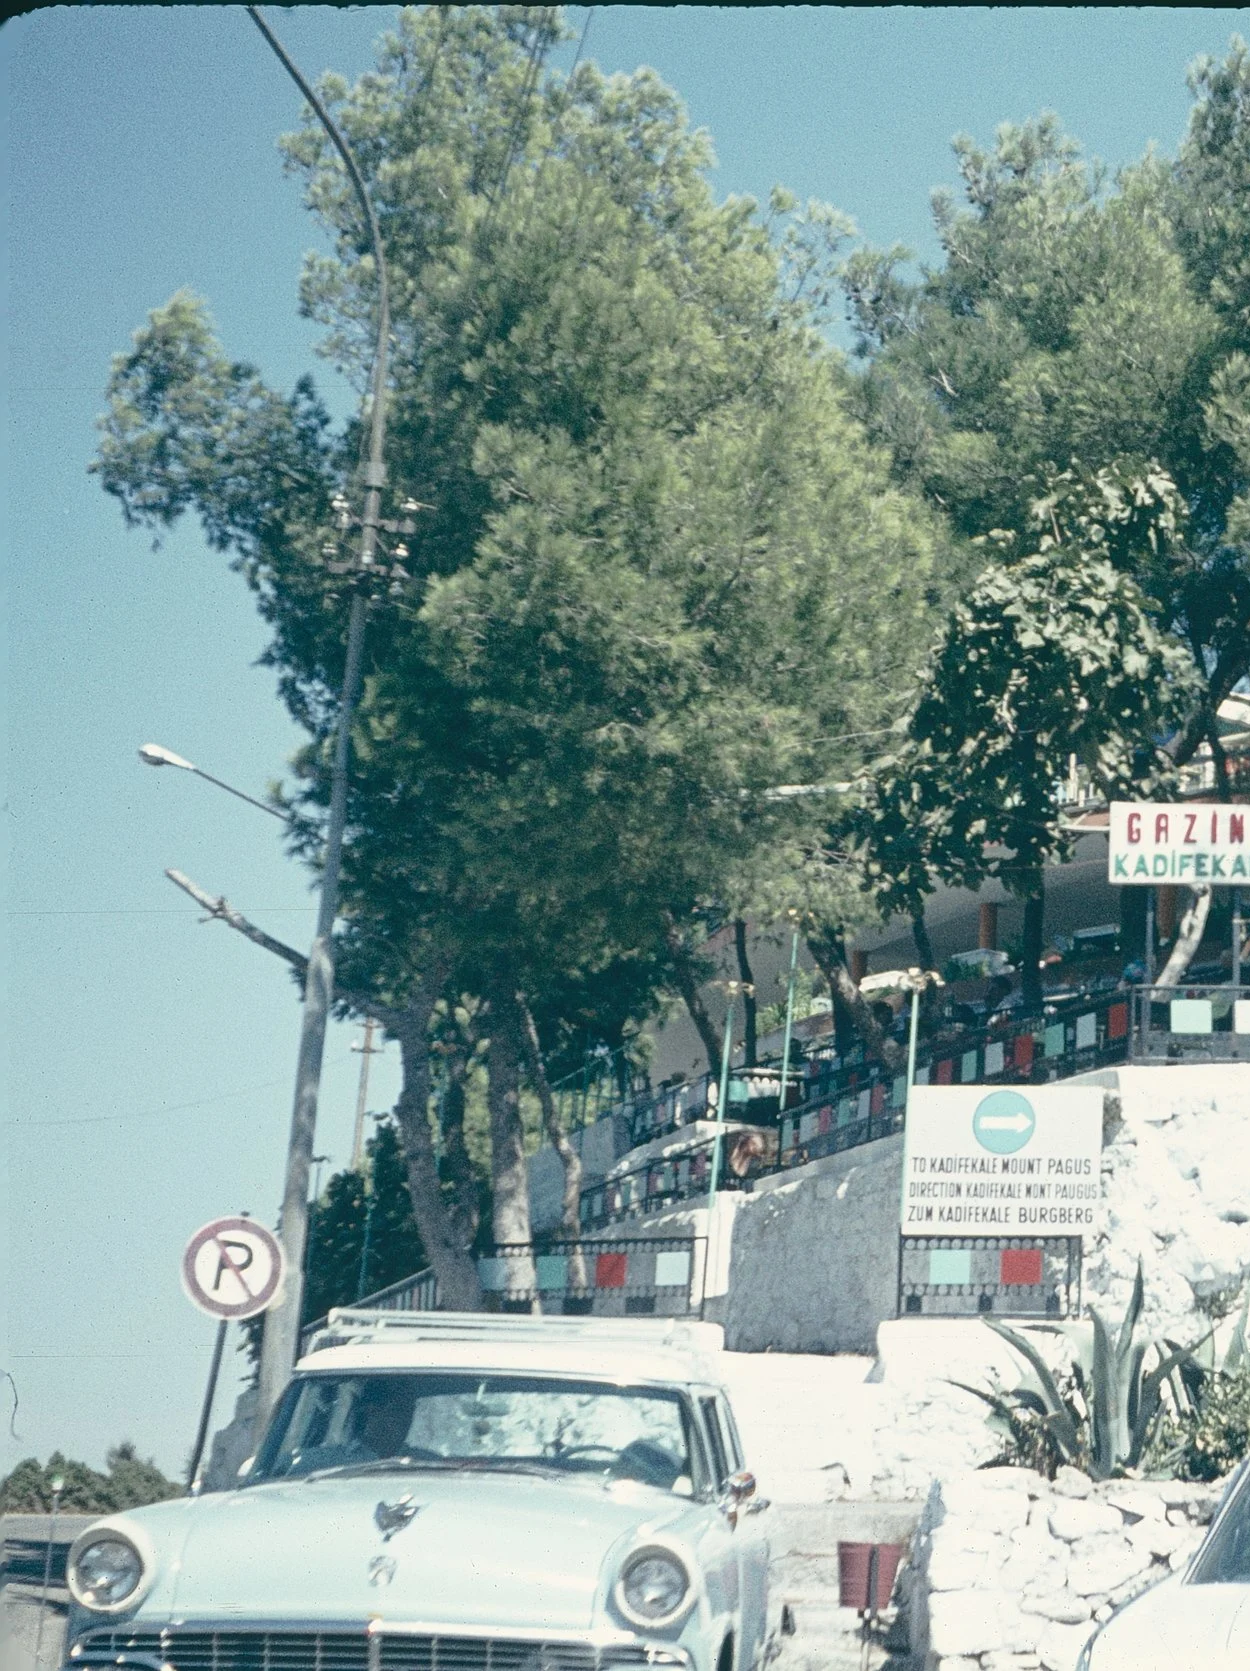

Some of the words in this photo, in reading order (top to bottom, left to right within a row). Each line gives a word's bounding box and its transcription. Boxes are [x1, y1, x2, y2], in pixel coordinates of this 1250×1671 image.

[912, 1157, 927, 1174] TO
[930, 1153, 998, 1174] KADİFEKALE
[1001, 1158, 1043, 1175] MOUNT
[1047, 1158, 1092, 1175] PAGUS
[908, 1181, 962, 1198] DIRECTION
[1025, 1182, 1053, 1199] MONT
[1054, 1183, 1098, 1200] PAUGUS
[907, 1205, 933, 1222] ZUM
[937, 1202, 1011, 1224] KADİFEKALE
[1018, 1206, 1094, 1225] BURGBERG
[212, 1239, 254, 1291] P
